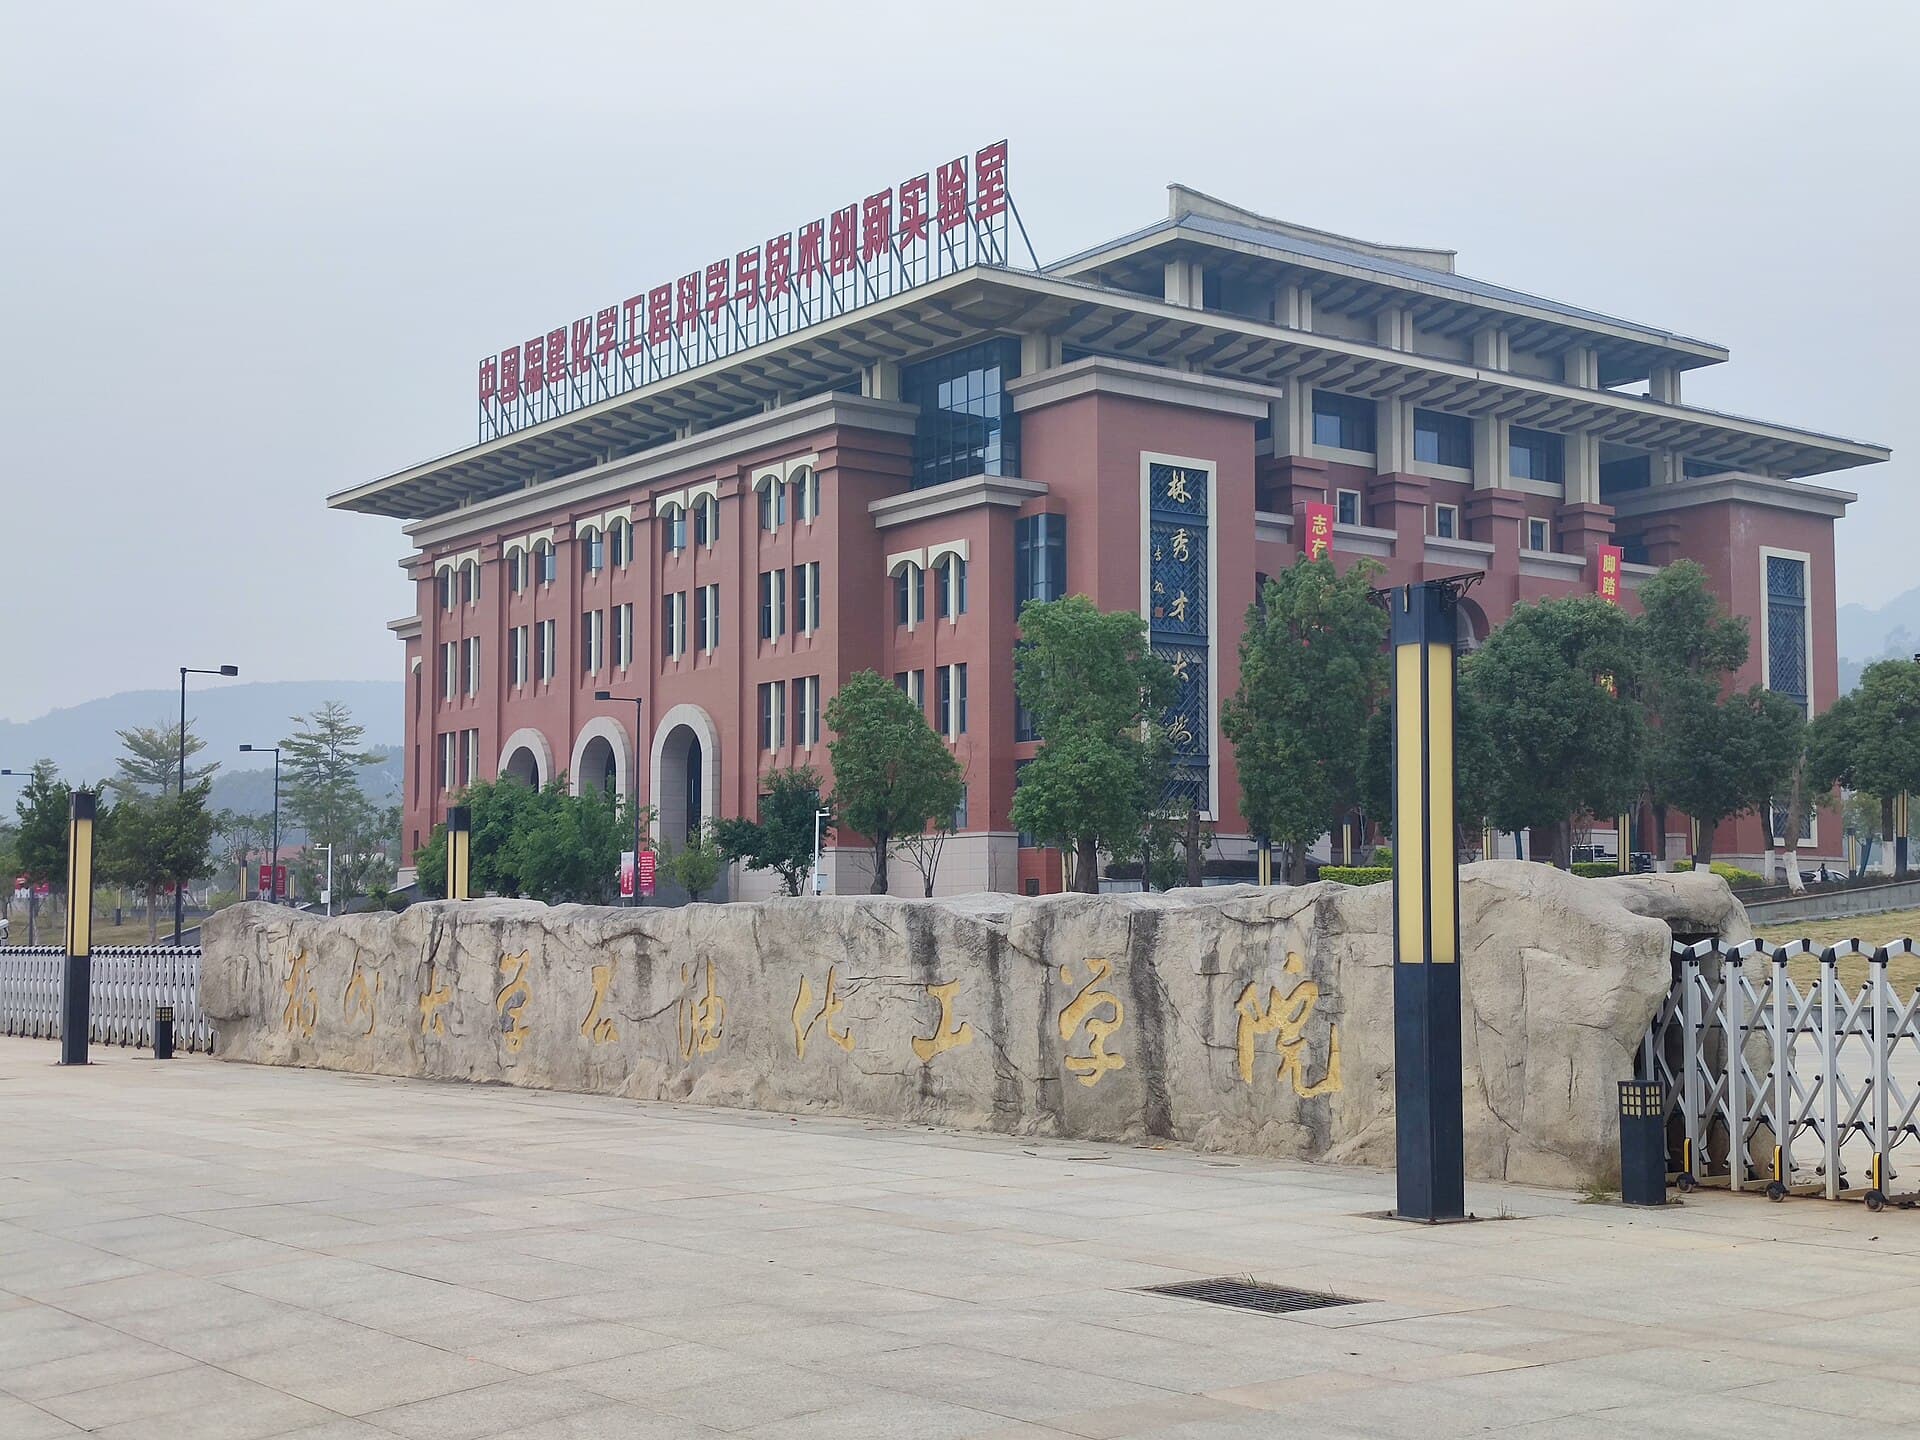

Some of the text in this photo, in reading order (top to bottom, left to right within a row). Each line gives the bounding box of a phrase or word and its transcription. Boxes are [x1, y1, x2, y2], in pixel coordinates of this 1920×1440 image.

[479, 142, 1007, 411] 中国福建化学工程科学与技术创新实验室
[283, 947, 1344, 1098] 福州大学石油化工学院
